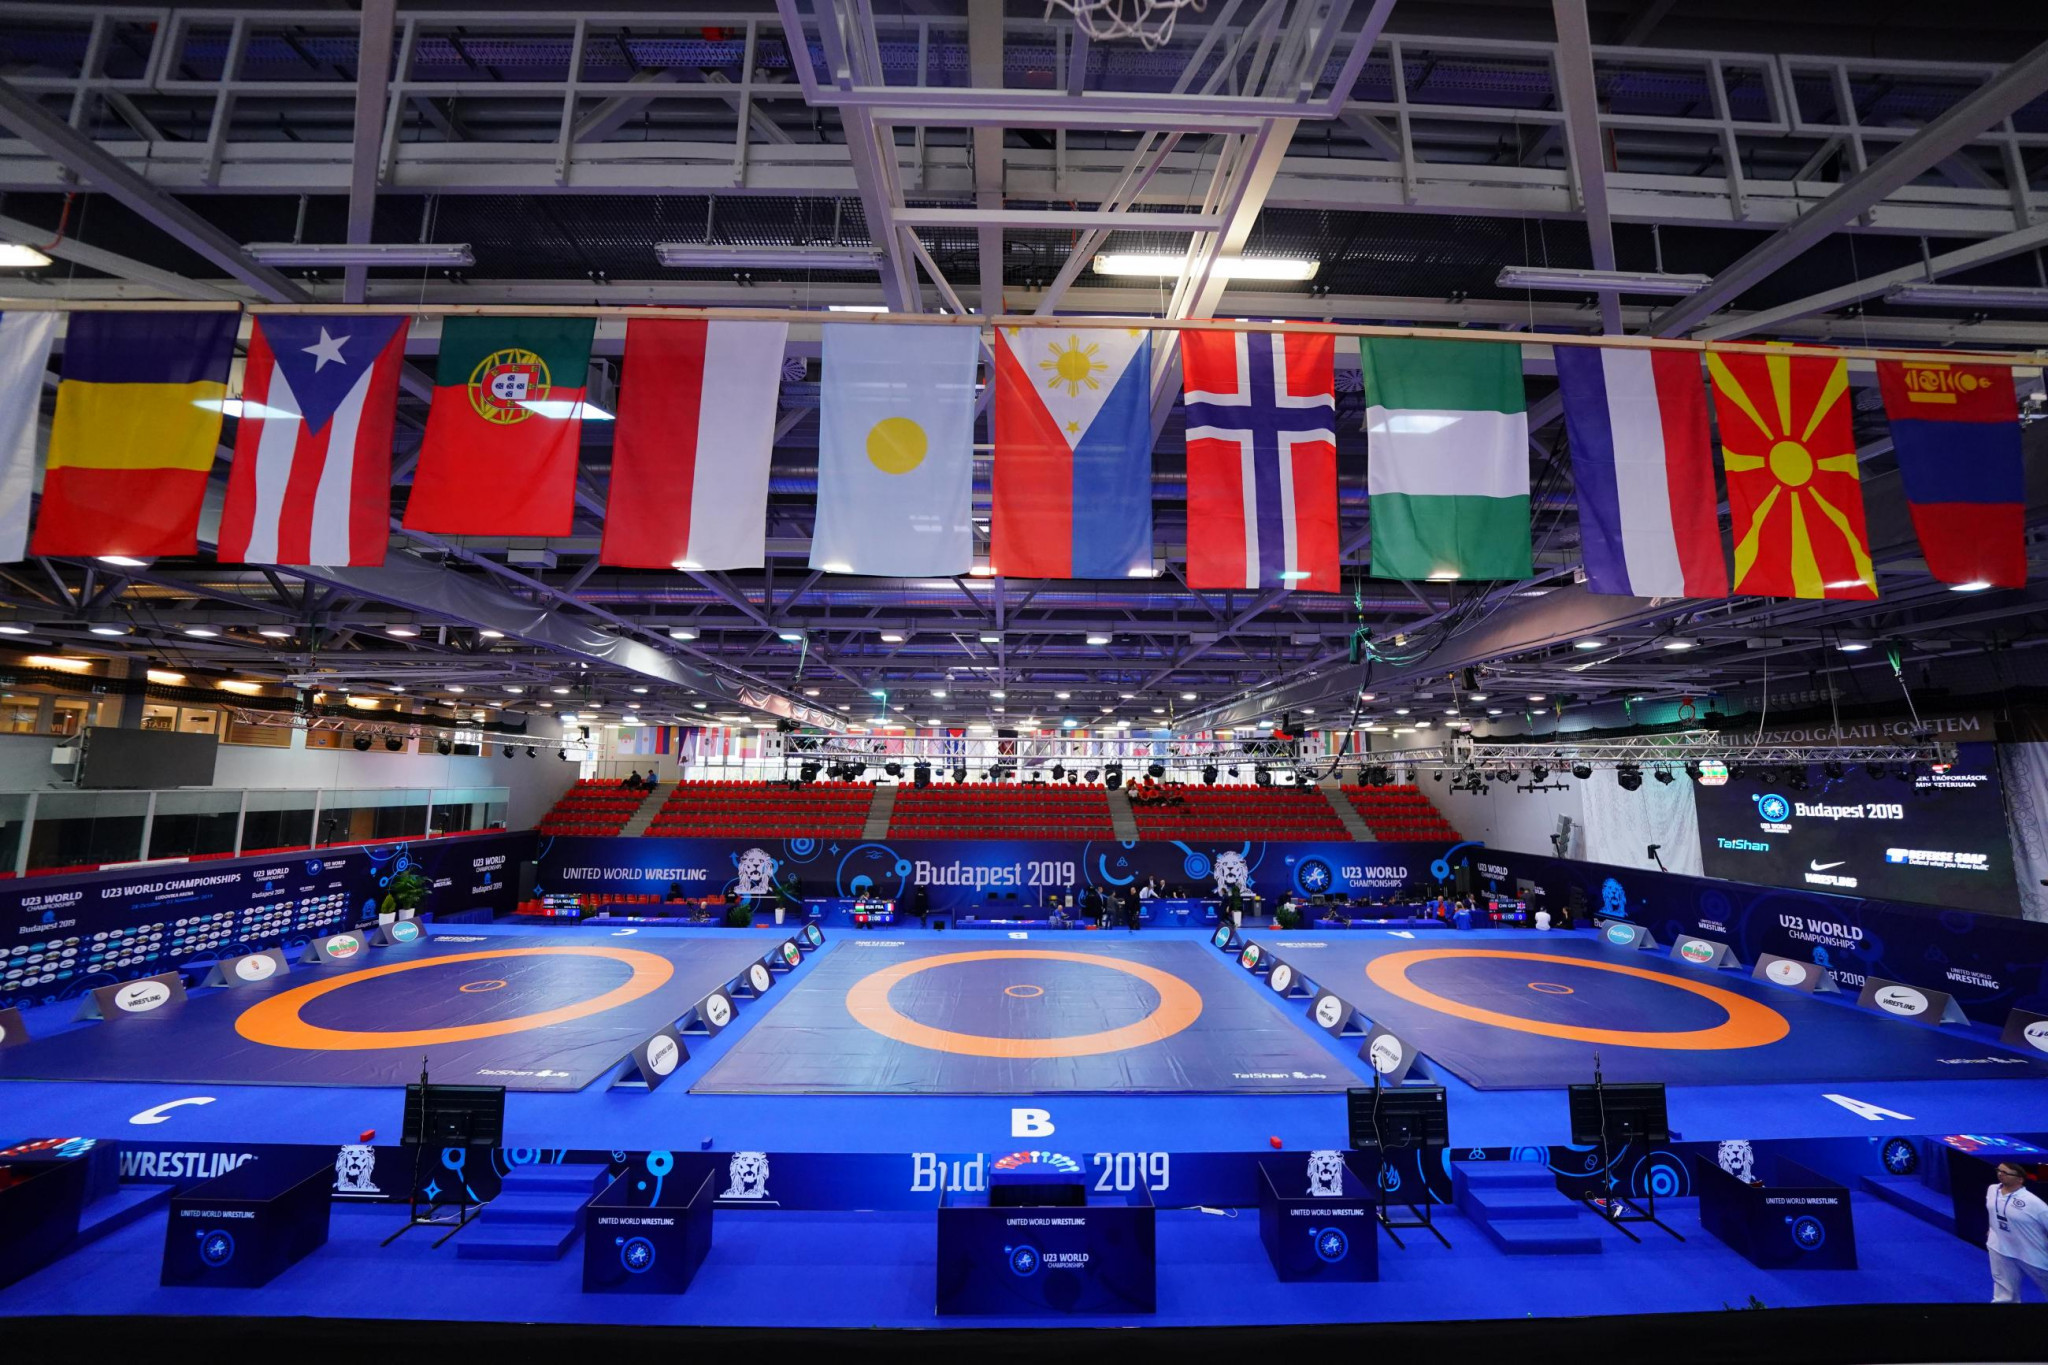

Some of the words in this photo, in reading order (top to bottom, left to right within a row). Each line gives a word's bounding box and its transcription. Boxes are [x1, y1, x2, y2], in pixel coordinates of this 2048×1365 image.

[1795, 803, 1865, 820] Budapest
[1867, 804, 1904, 820] 2019
[1717, 837, 1770, 852] TaiShan
[473, 858, 484, 867] U23
[485, 855, 506, 866] WORLD
[253, 870, 265, 878] U23
[266, 867, 290, 877] WORLD
[563, 867, 602, 880] UNITED
[603, 867, 643, 880] WORLD
[645, 868, 707, 881] WRESTLING
[914, 860, 1021, 892] Budapest
[1027, 860, 1076, 887] 2019
[1341, 866, 1362, 879] U23
[1365, 866, 1408, 879] WORLD
[1488, 864, 1508, 876] WORLD
[101, 887, 122, 899] U23
[124, 882, 163, 897] WORLD
[165, 873, 241, 891] CHAMPIONSHIPS
[1349, 879, 1403, 888] CHAMPIONSHIPS
[1804, 873, 1858, 888] WRESTLING
[21, 896, 42, 907] U23
[44, 891, 83, 904] WORLD
[26, 901, 76, 912] CHAMPIONSHIPS
[19, 922, 58, 934] Budapest
[58, 919, 76, 928] 2019
[1698, 922, 1727, 933] WRESTLING
[1779, 914, 1803, 931] U23
[1807, 919, 1863, 941] WORLD
[1789, 929, 1856, 950] CHAMPIONSHIPS
[1840, 971, 1865, 987] 2019
[1950, 967, 1971, 976] UNITED
[1970, 971, 1993, 980] WORLD
[1946, 972, 1999, 990] WRESTLING
[128, 995, 161, 1007] WRESTLING
[1883, 998, 1916, 1011] WRESTLING
[129, 1096, 217, 1125] C
[1821, 1094, 1916, 1121] A
[1011, 1108, 1055, 1138] B
[1093, 1152, 1170, 1192] 2019
[202, 1210, 221, 1218] WORLD
[222, 1210, 255, 1219] WRESTLING
[598, 1217, 619, 1225] UNITED
[620, 1217, 640, 1225] WORLD
[641, 1218, 674, 1226] WRESTLING
[1006, 1218, 1028, 1226] UNITED
[1029, 1218, 1050, 1226] WORLD
[1051, 1218, 1086, 1226] WRESTLING
[1043, 1253, 1057, 1262] U23
[1059, 1253, 1089, 1262] WORLD
